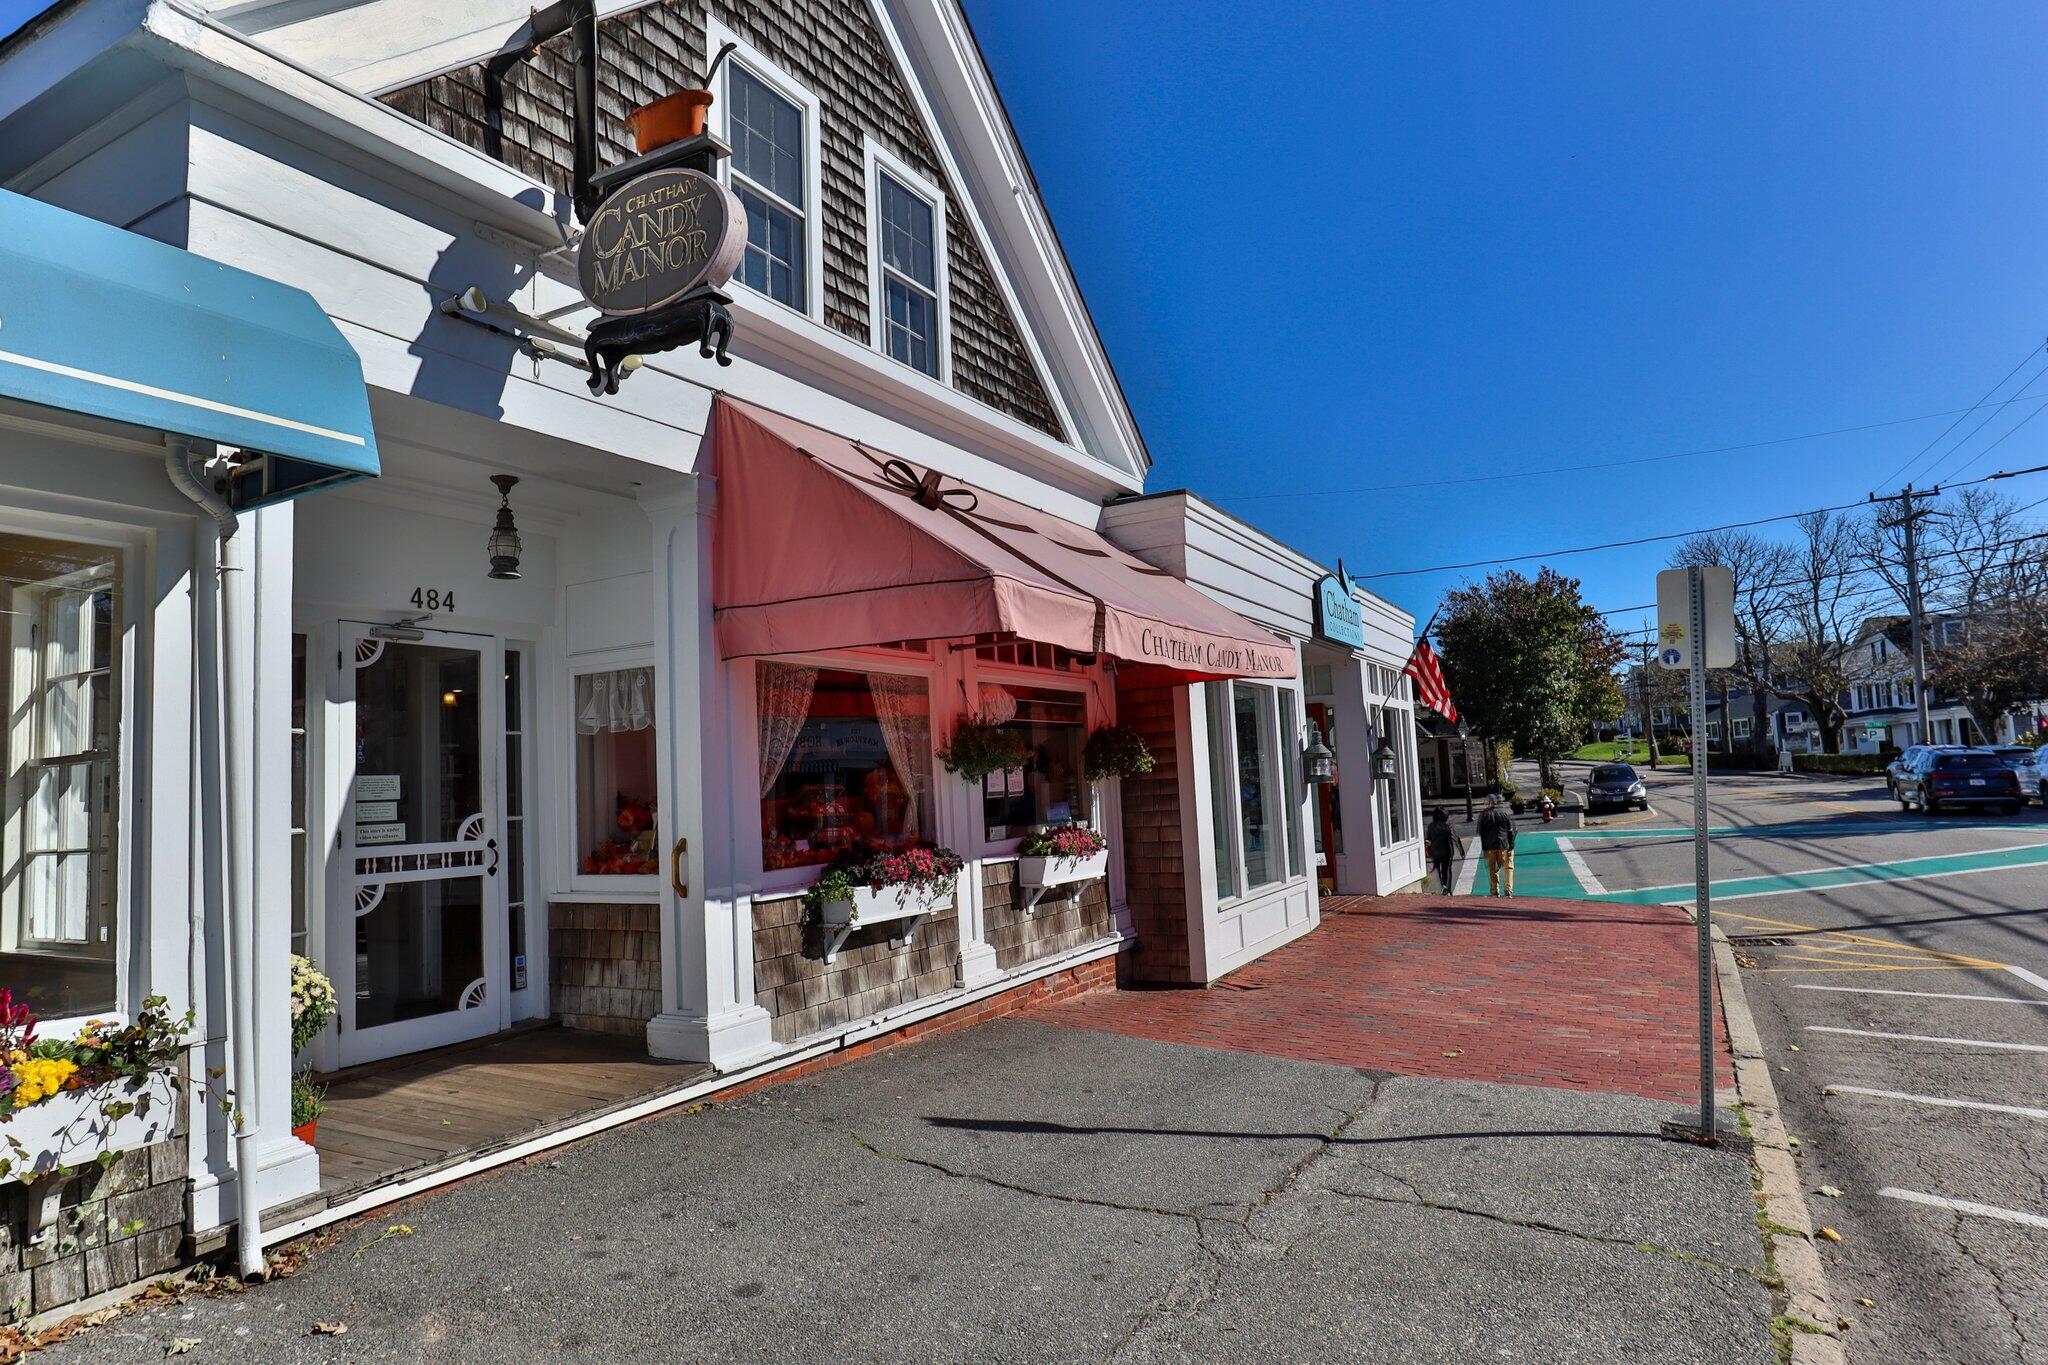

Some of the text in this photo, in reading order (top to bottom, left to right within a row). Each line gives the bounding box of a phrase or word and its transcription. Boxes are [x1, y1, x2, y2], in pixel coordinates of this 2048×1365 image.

[625, 176, 699, 213] CHATHAM
[592, 192, 708, 259] CANDY
[592, 229, 708, 299] MANOR
[410, 586, 455, 612] 484
[1326, 590, 1359, 627] Chatham
[1142, 628, 1284, 672] CHATHAM CANDY MANOR
